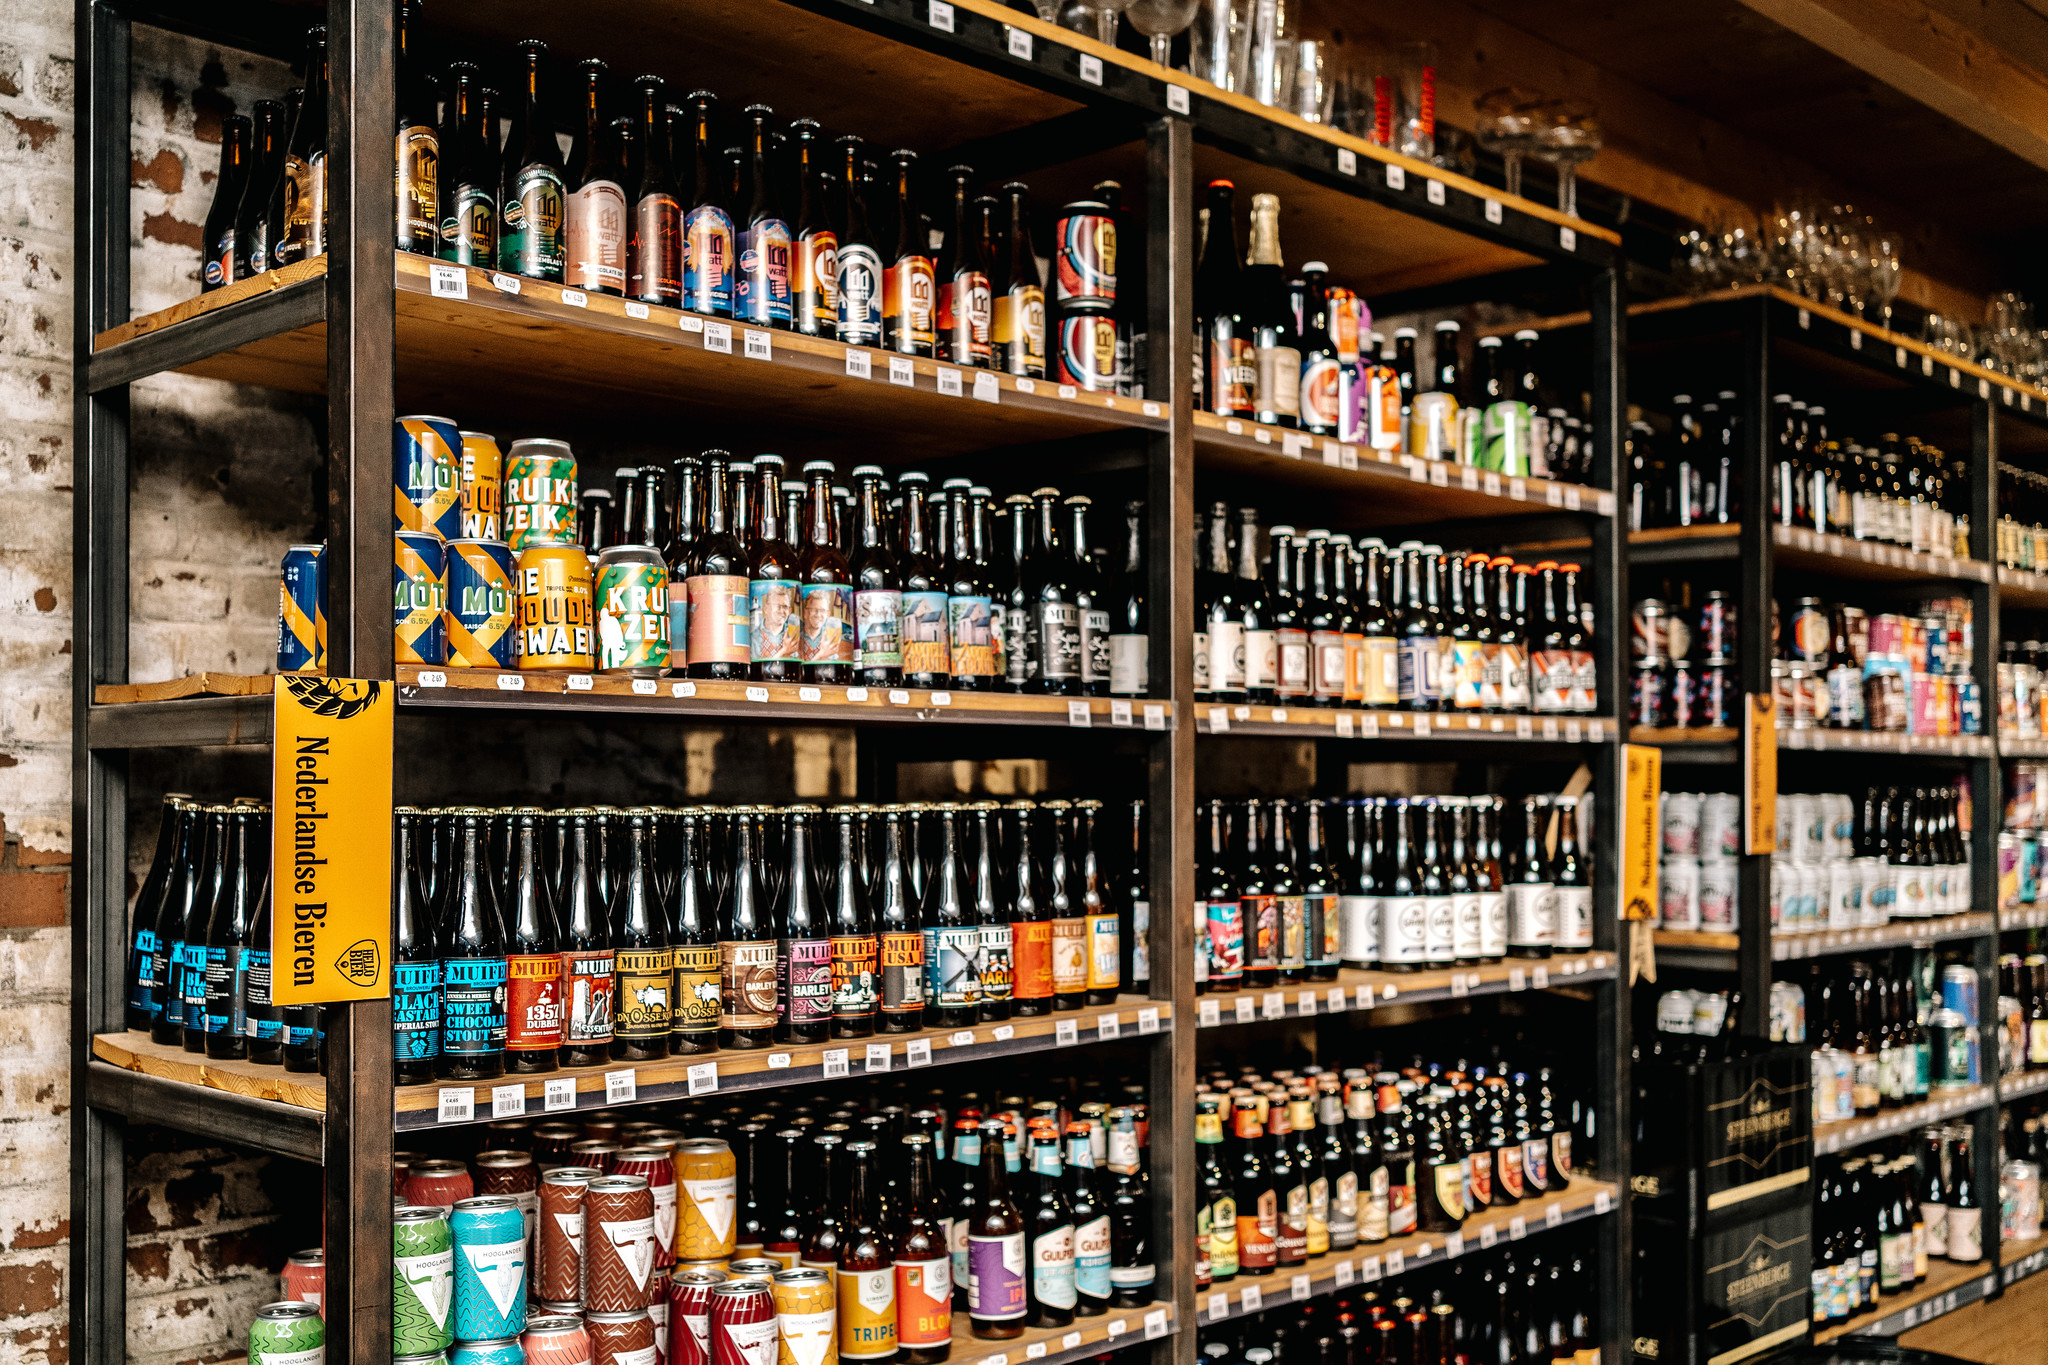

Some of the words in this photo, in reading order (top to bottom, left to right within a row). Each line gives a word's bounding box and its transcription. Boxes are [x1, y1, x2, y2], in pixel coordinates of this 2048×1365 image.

[434, 497, 452, 506] 6.5%
[410, 617, 430, 626] 6.5%
[488, 622, 506, 631] 6.5%
[294, 736, 329, 894] Nederlandse
[293, 902, 327, 987] Bieren
[350, 950, 364, 978] BIER
[362, 949, 375, 977] HELLO
[886, 951, 915, 965] USA
[745, 981, 771, 992] BARLEY
[793, 984, 829, 997] BARLEY
[446, 1002, 492, 1015] SWEET
[526, 1003, 560, 1021] 1357
[526, 1019, 560, 1029] DUBBEL
[446, 1029, 491, 1042] STOUT
